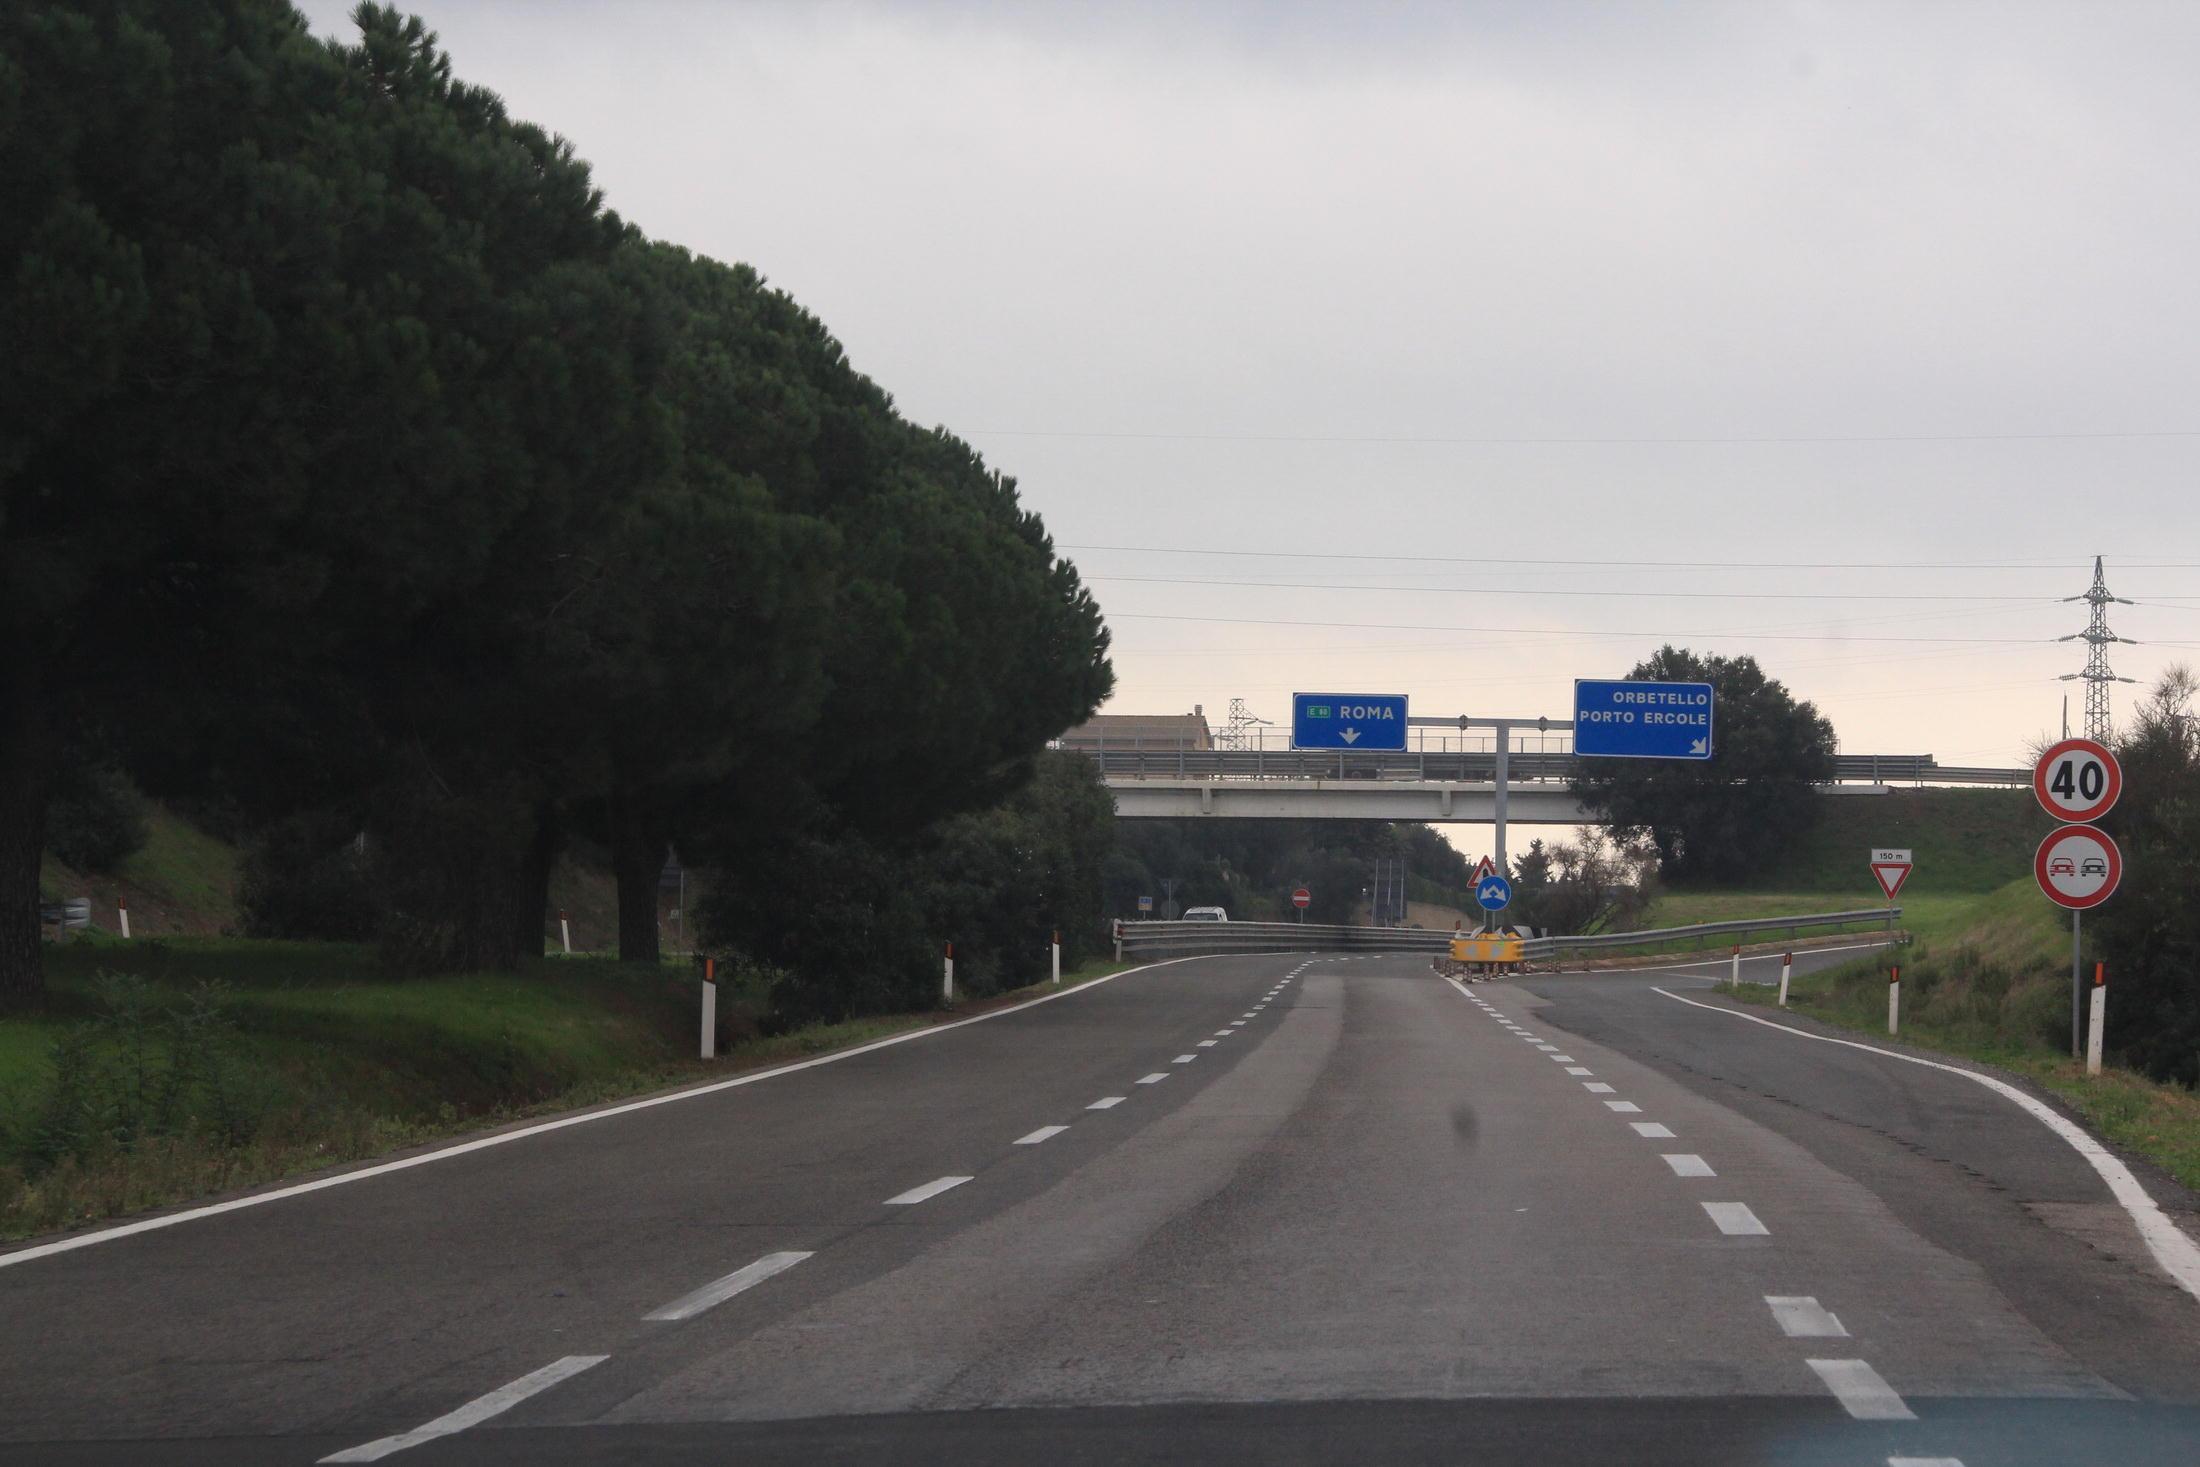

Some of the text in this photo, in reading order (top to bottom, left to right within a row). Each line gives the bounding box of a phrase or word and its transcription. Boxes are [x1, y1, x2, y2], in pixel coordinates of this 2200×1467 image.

[1613, 691, 1707, 705] ORBETELLO
[1340, 706, 1394, 720] ROMA
[1580, 710, 1707, 725] PORTO ERCOLE
[2051, 760, 2104, 801] 40
[1879, 852, 1893, 860] 150
